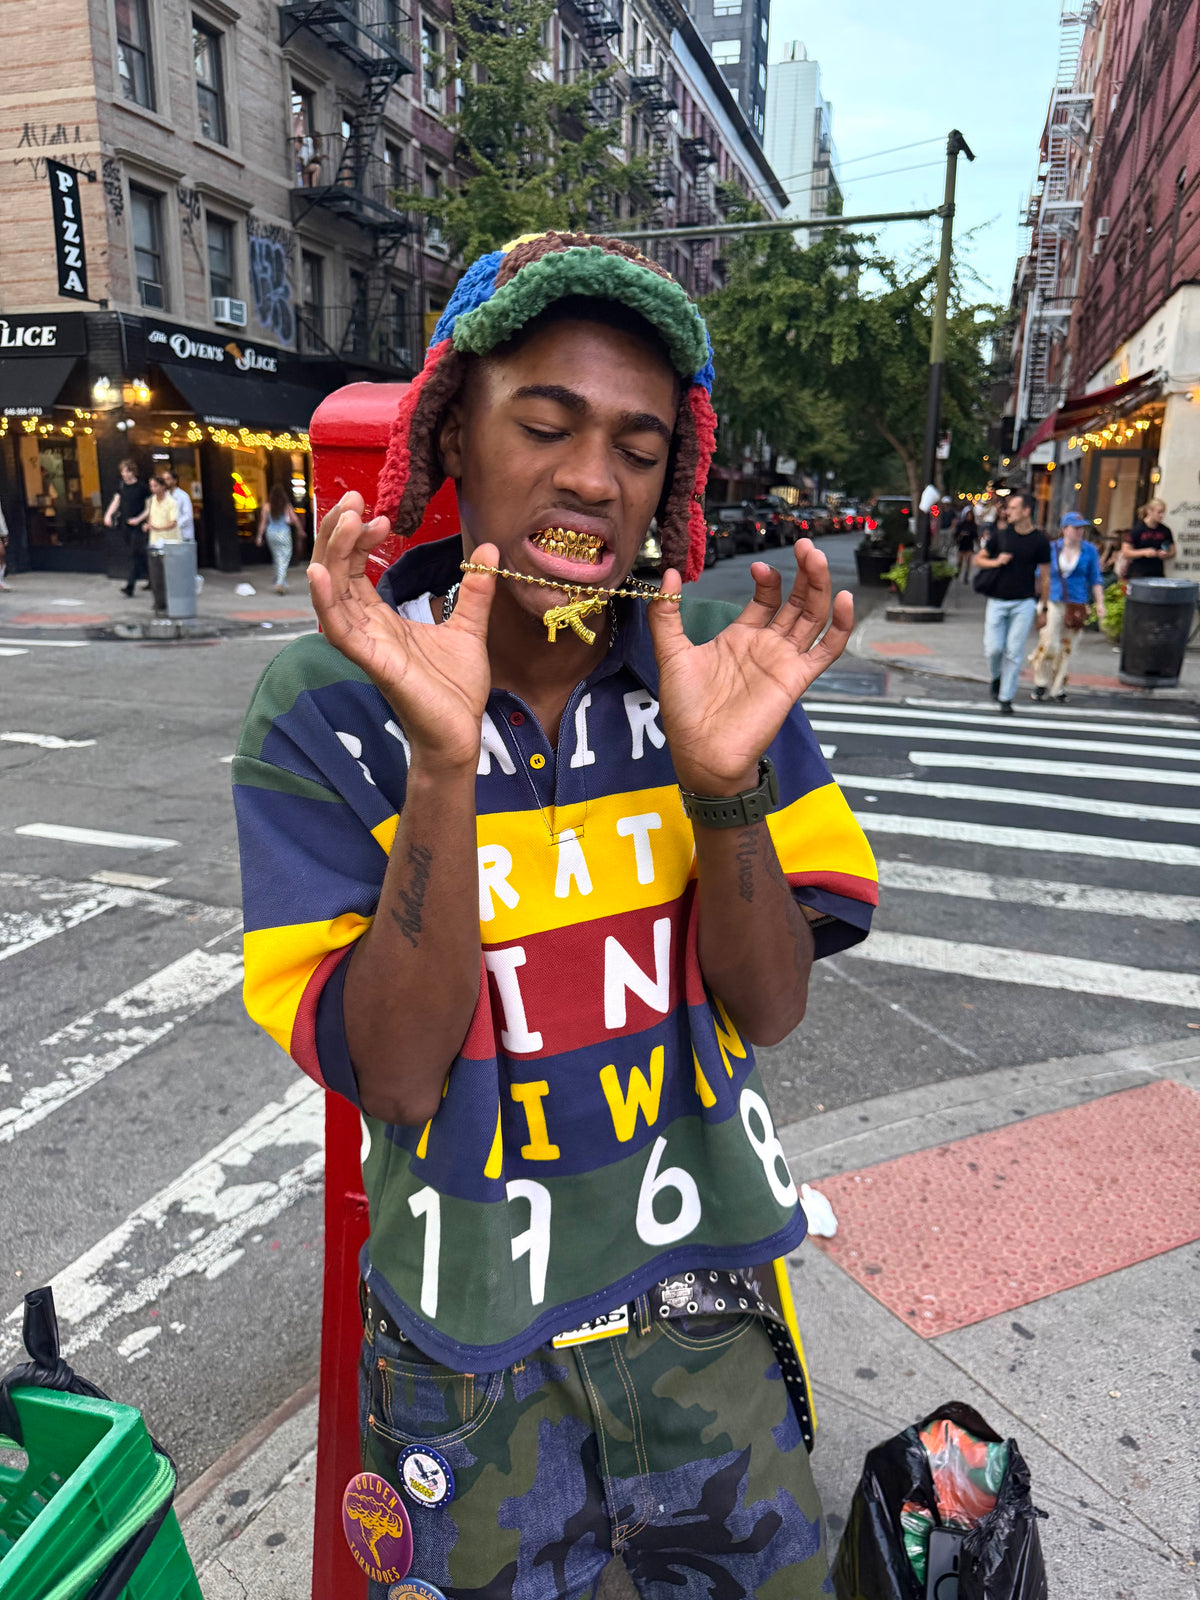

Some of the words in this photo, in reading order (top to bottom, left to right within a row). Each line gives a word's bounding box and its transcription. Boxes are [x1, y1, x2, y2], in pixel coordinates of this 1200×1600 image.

[56, 169, 85, 293] PIZZA
[169, 333, 224, 361] OVEN'S
[235, 348, 277, 372] SLICE
[355, 1475, 398, 1509] GOLDEN
[350, 1541, 400, 1584] TORNADOES
